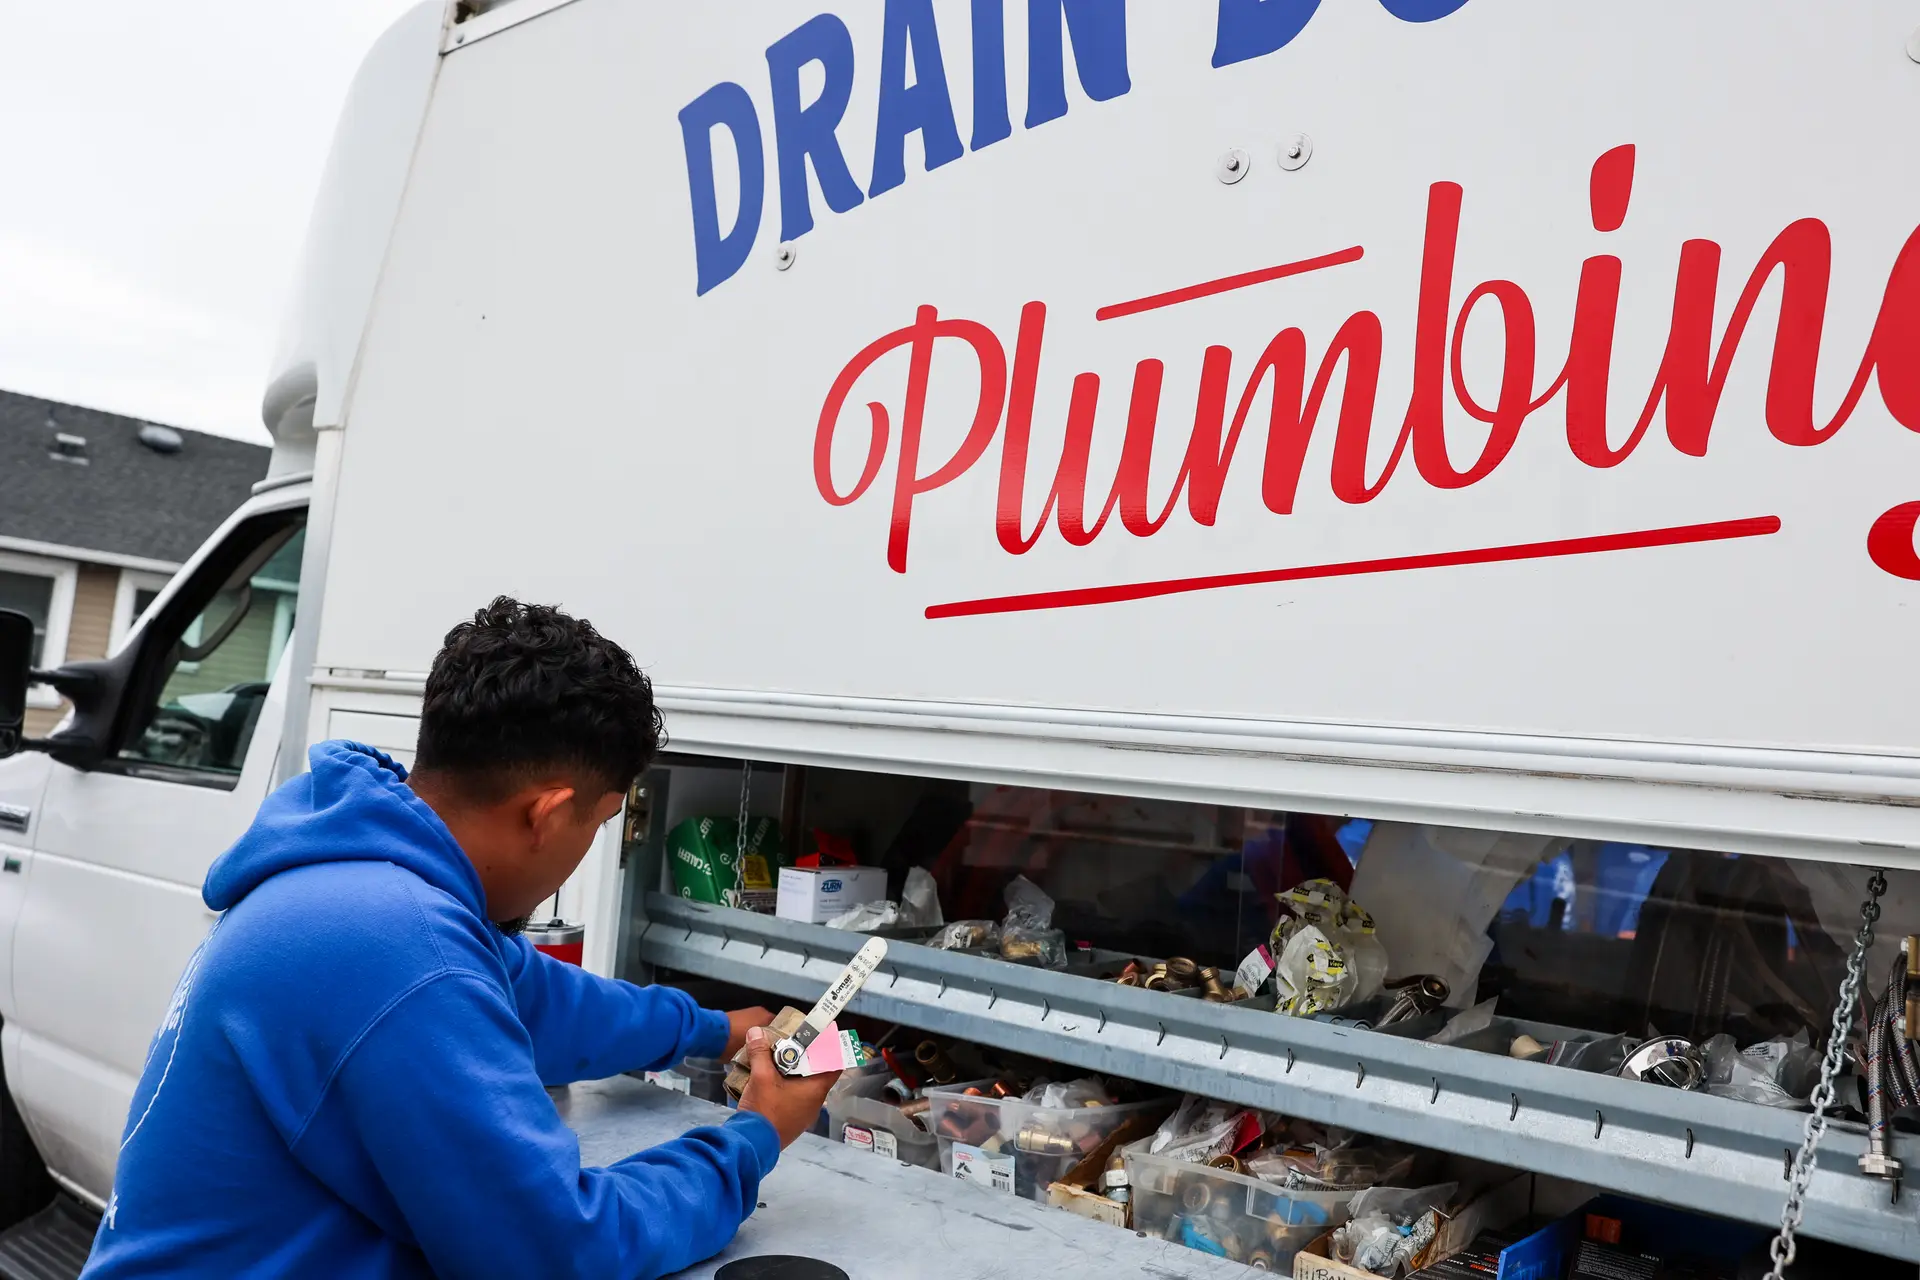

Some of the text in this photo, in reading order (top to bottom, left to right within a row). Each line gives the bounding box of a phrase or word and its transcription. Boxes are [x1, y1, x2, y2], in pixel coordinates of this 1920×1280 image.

[679, 0, 1132, 296] DRAIN
[677, 846, 704, 871] CALEFFI
[821, 880, 843, 892] ZURN
[831, 973, 852, 1000] Jomar
